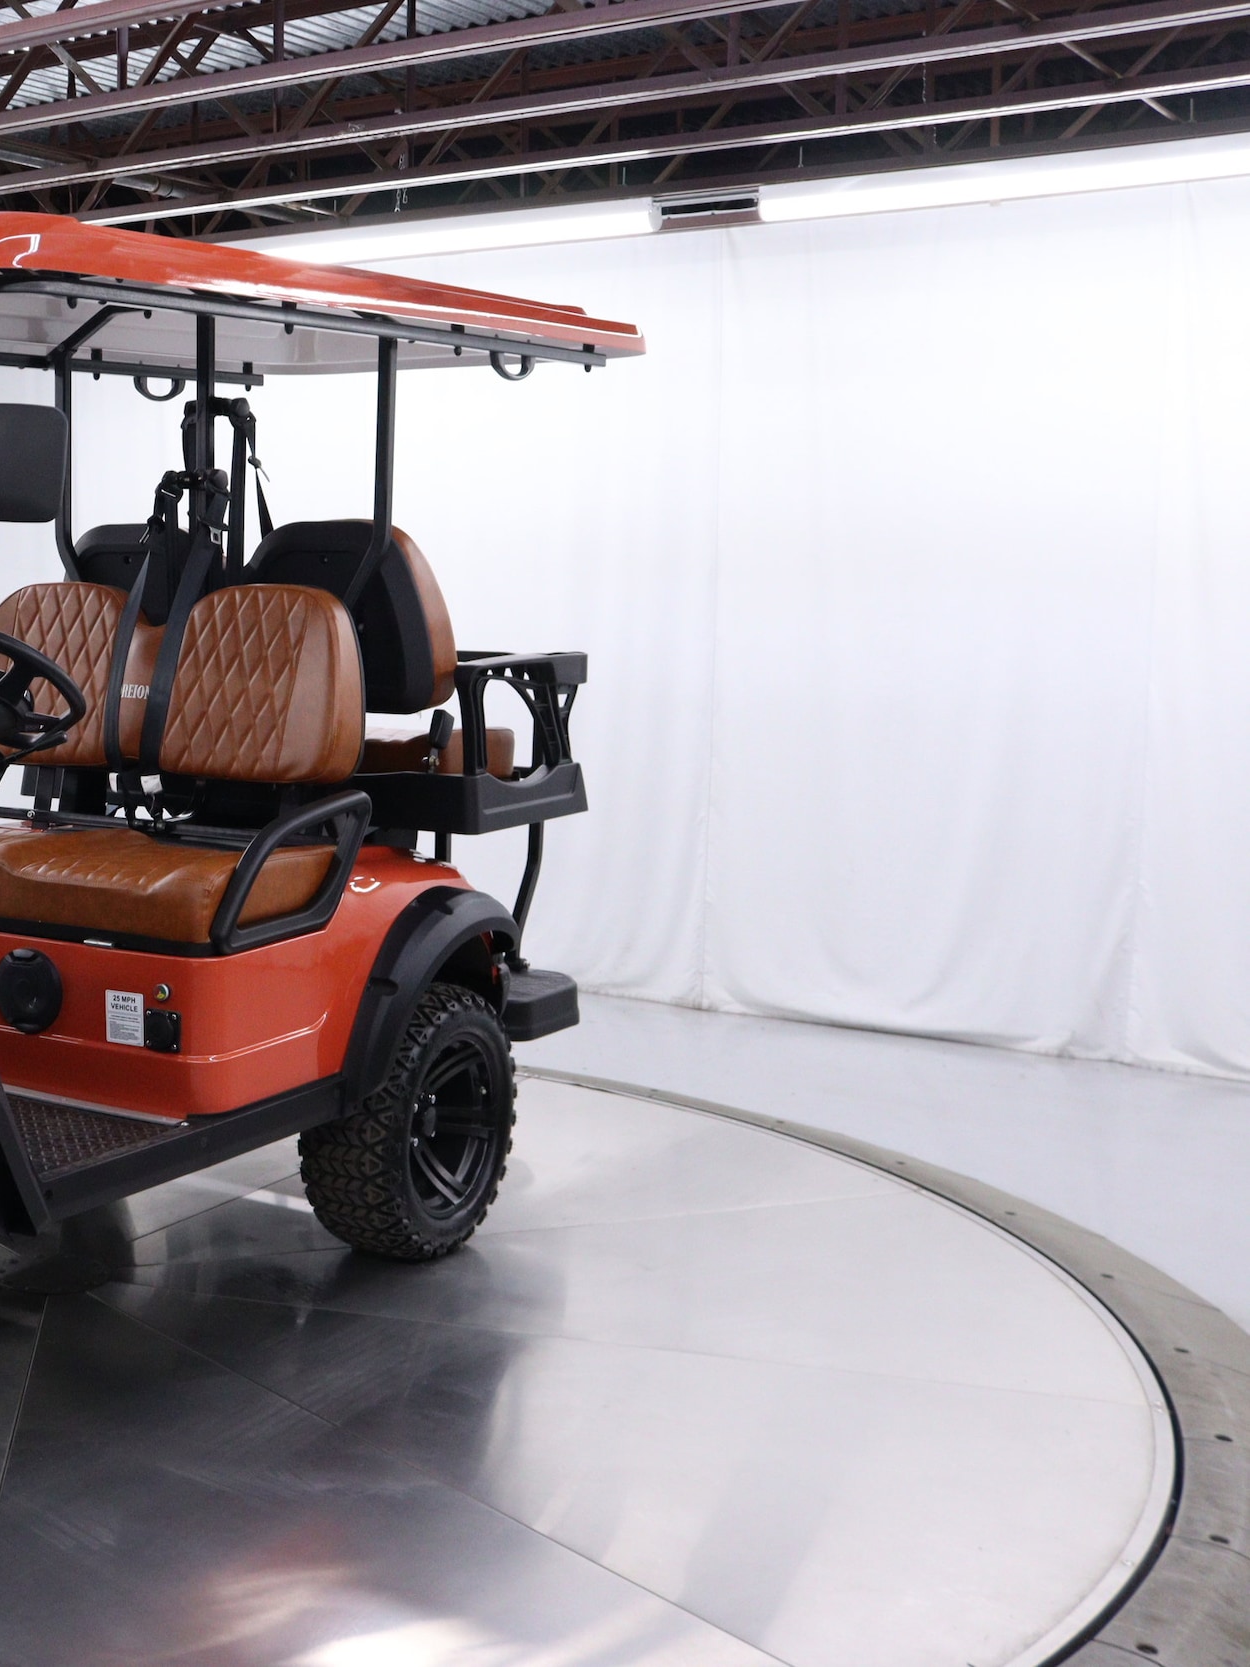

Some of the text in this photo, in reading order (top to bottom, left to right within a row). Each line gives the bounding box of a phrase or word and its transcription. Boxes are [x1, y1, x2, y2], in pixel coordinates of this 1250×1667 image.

[113, 994, 136, 1003] 25 MPH
[111, 1003, 138, 1012] VEHICLE
